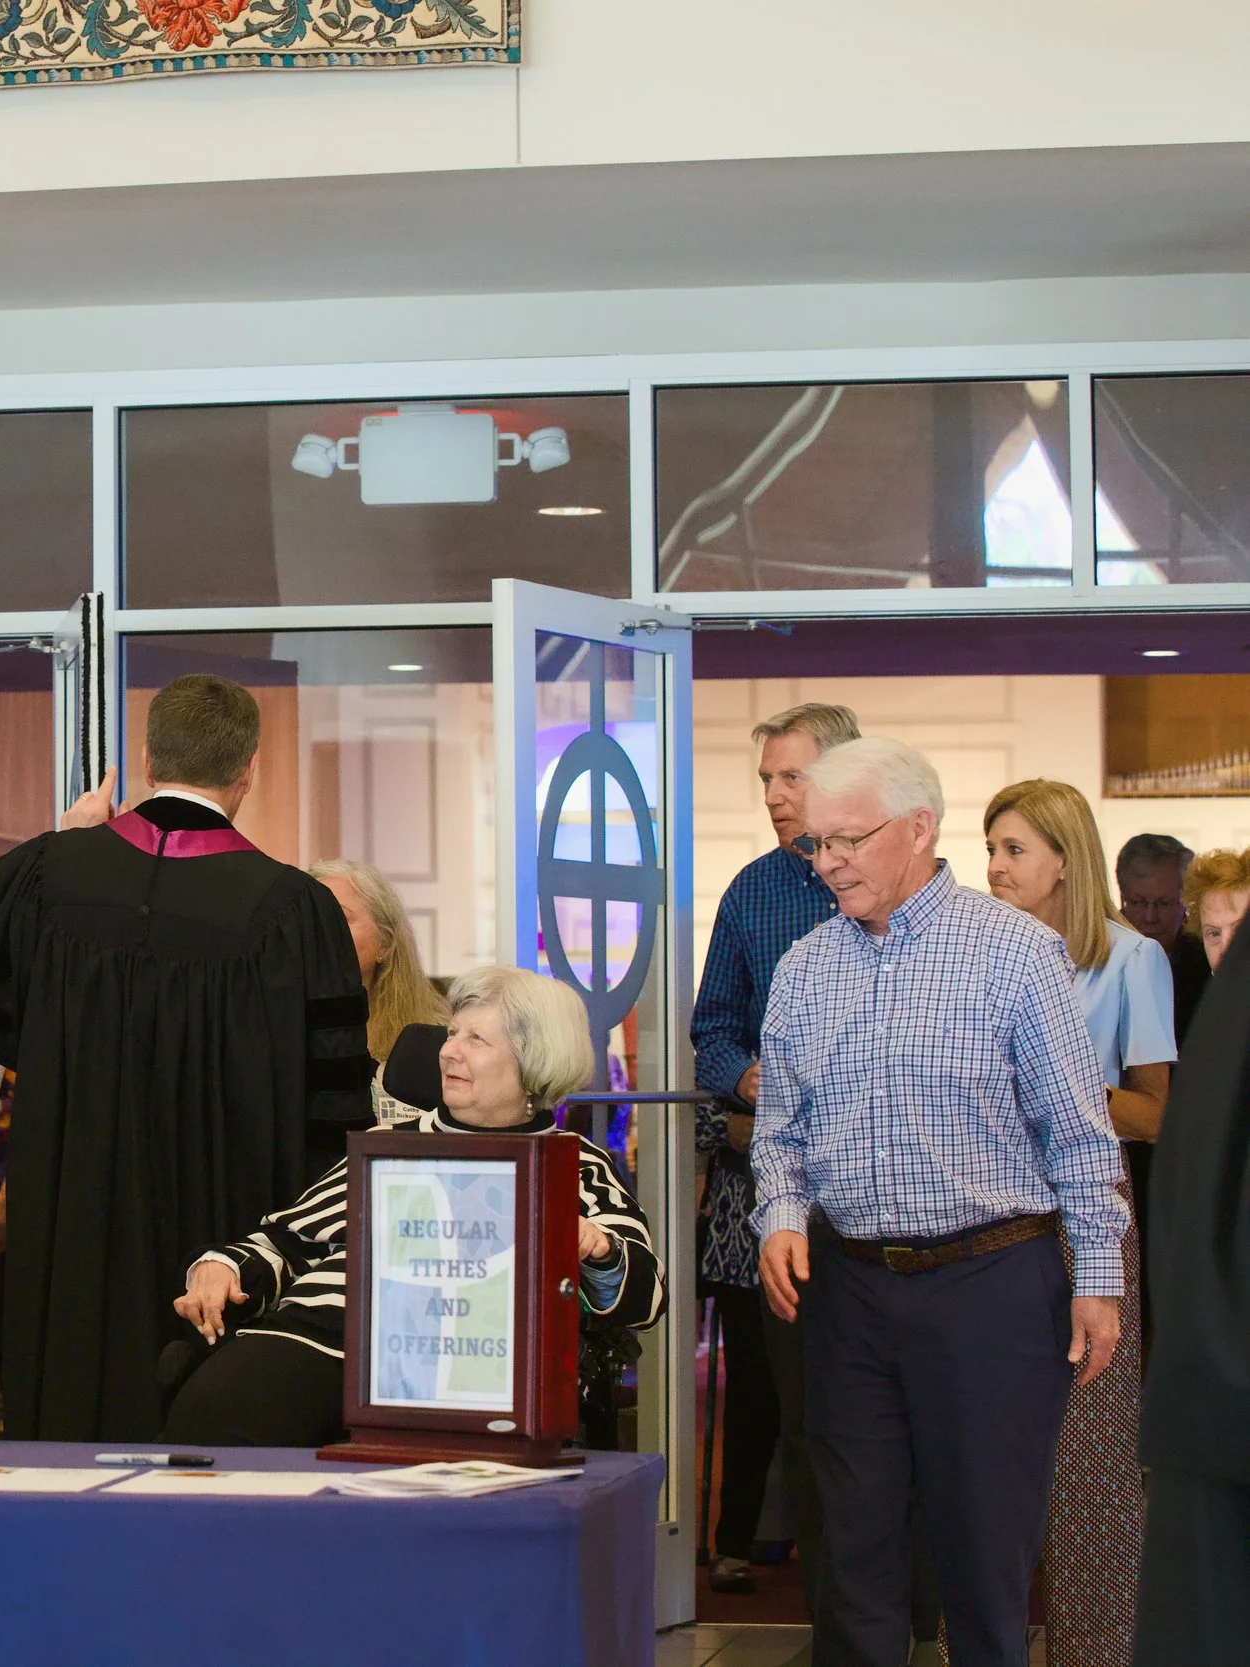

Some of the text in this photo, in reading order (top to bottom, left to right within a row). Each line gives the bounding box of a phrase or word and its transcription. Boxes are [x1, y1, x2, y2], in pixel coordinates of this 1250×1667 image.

[402, 1106, 420, 1114] Cathy
[398, 1219, 501, 1241] REGULAR
[410, 1258, 488, 1279] TITHES
[425, 1297, 471, 1317] AND
[386, 1333, 508, 1358] OFFERINGS
